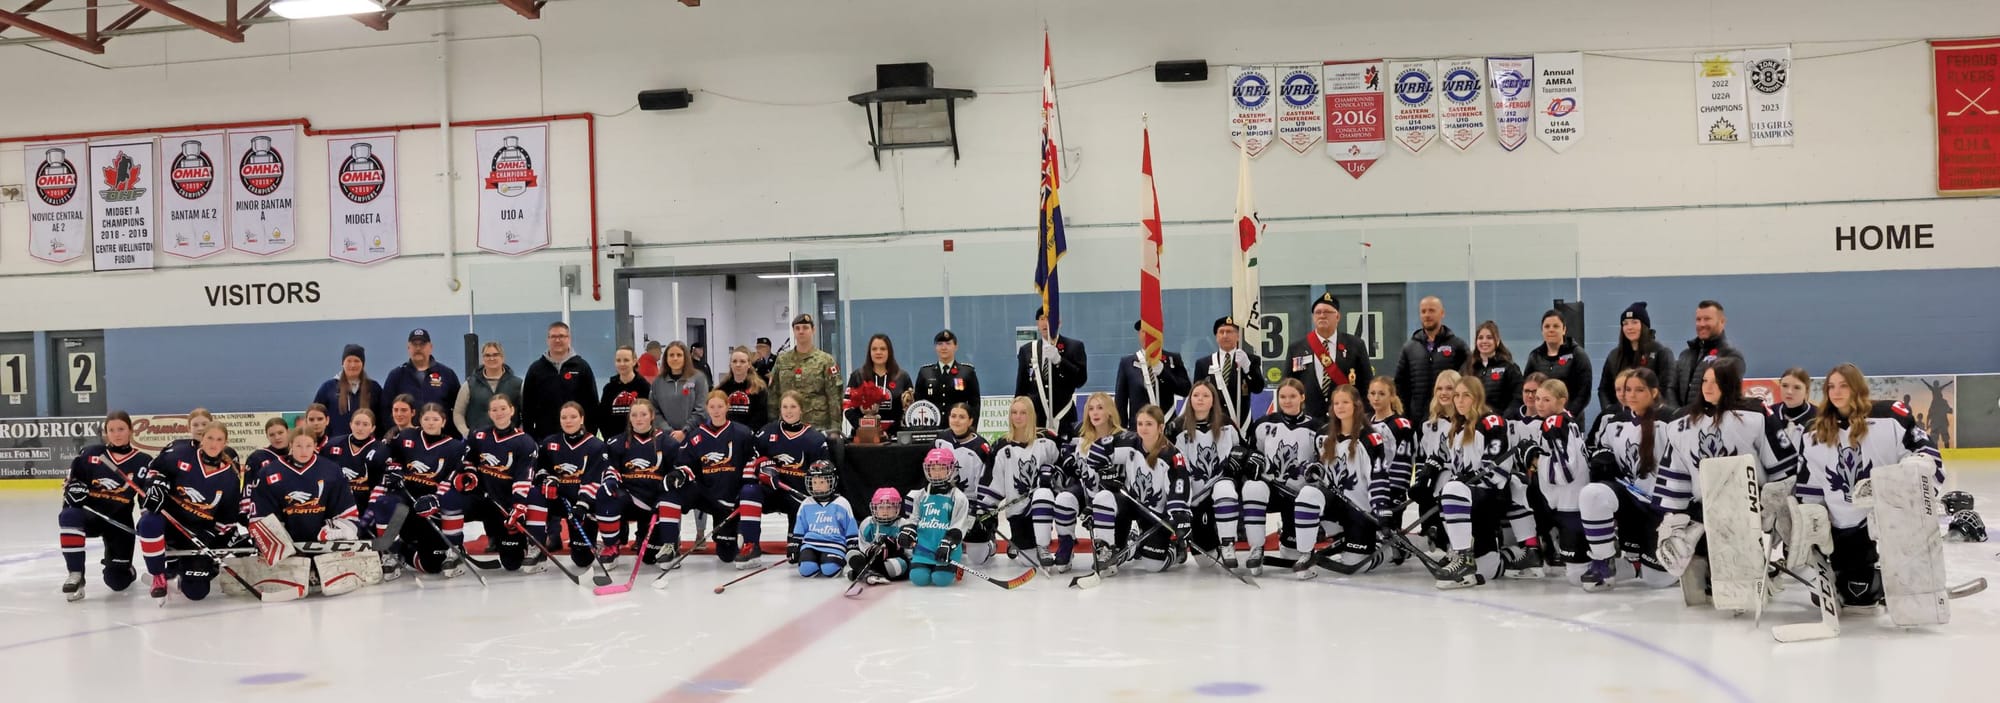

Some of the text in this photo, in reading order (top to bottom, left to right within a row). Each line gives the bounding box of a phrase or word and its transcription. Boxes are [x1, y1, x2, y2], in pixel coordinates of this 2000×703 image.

[1759, 61, 1777, 69] ZONE
[1543, 69, 1574, 77] Annual
[1764, 70, 1772, 82] 8
[1394, 81, 1434, 93] WRRL
[1442, 79, 1481, 91] WRRL
[1545, 78, 1572, 86] AMRA
[1232, 85, 1271, 97] WRRL
[1280, 83, 1320, 96] WRRL
[1700, 104, 1743, 113] CHAMPIONS
[1331, 109, 1377, 125] 2016
[1752, 120, 1792, 129] U13 GIRLS
[242, 164, 280, 175] OMHA
[497, 161, 526, 169] OMHA
[1347, 162, 1366, 172] U16
[173, 167, 211, 179] OMHA
[341, 171, 382, 183] OMHA
[496, 170, 527, 178] CHAMPIONS
[38, 175, 75, 186] OMHA
[347, 191, 378, 203] CHAMPIONS
[236, 198, 292, 211] MINOR BANTAM
[32, 210, 84, 222] NOVICE CENTRAL
[105, 206, 140, 216] MIDGET A
[171, 208, 217, 221] BANTAM AE 2
[260, 211, 266, 221] A
[500, 209, 524, 220] U10 A
[102, 217, 145, 228] CHAMPIONS
[345, 213, 381, 224] MIDGET A
[52, 223, 66, 232] AE 2
[101, 230, 120, 240] 2018
[128, 229, 148, 238] 2019
[1835, 223, 1935, 251] HOME
[95, 243, 117, 254] CENTRE
[114, 255, 136, 265] FUSION
[205, 280, 320, 307] VISITORS
[1261, 315, 1283, 359] 3
[1354, 314, 1376, 357] 4
[6, 356, 21, 393] 1
[73, 354, 92, 392] 2
[1265, 425, 1277, 437] 74
[1616, 425, 1623, 437] 7
[366, 449, 376, 461] A
[1, 467, 71, 476] Historic Downtown
[137, 466, 147, 478] C
[1175, 479, 1185, 494] 8
[1746, 466, 1760, 514] CCM
[923, 502, 941, 516] Tim
[815, 510, 833, 523] Tim
[1346, 542, 1368, 550] CCM
[1817, 562, 1835, 617] CCM
